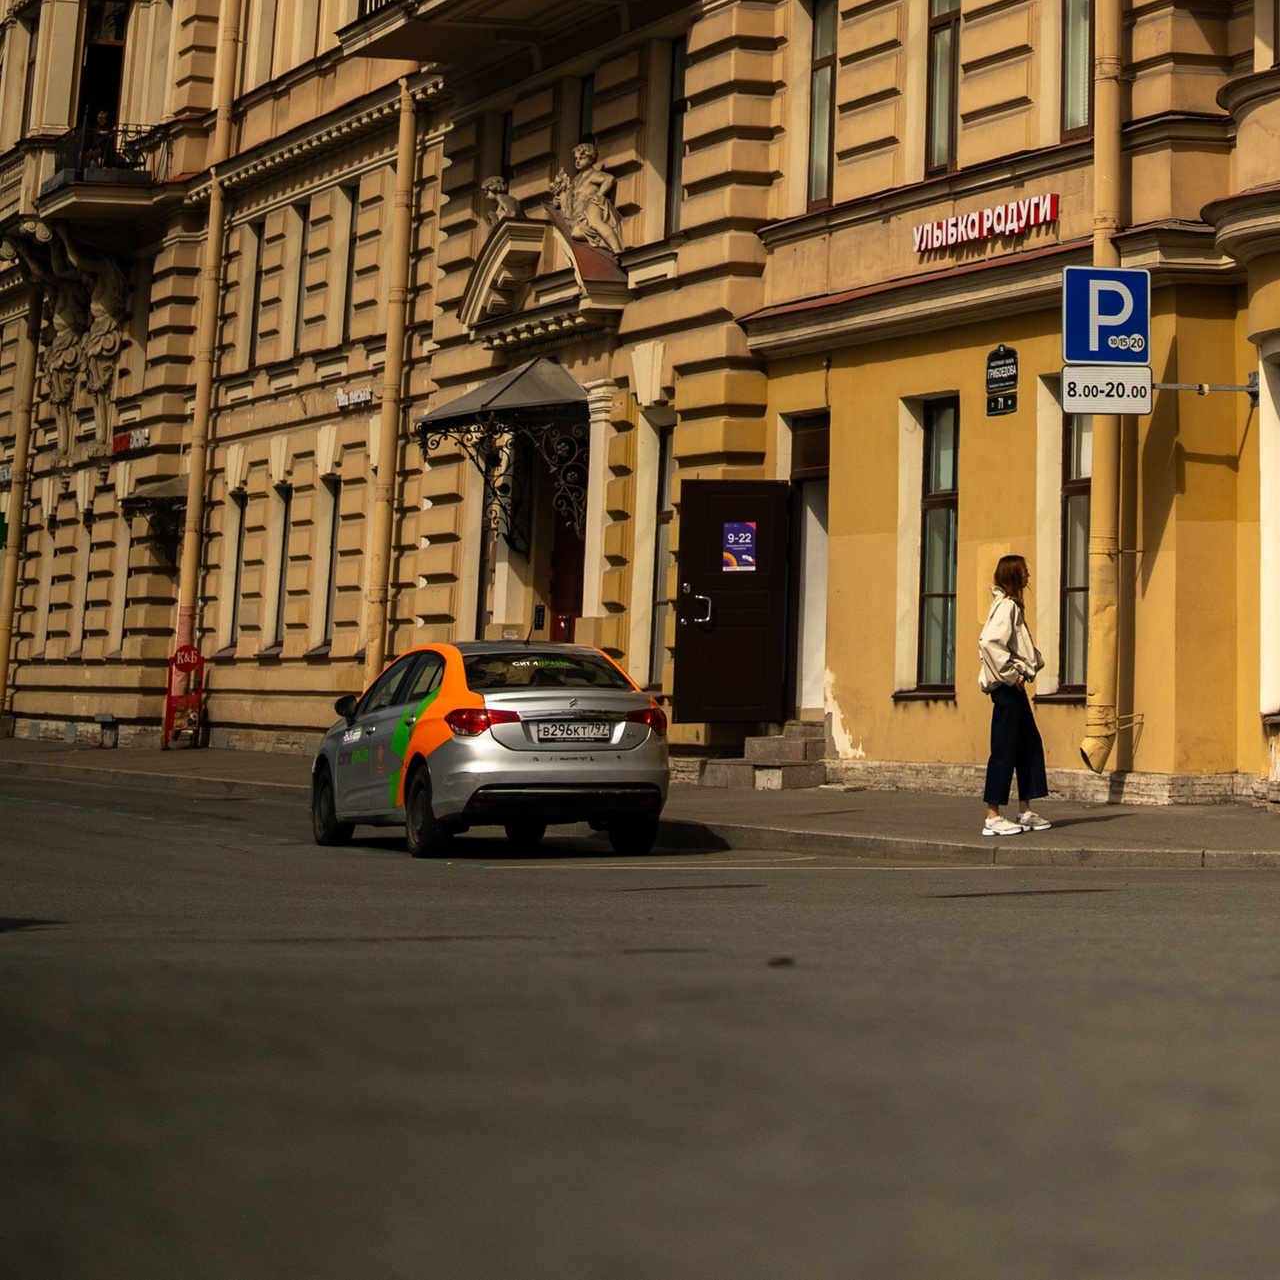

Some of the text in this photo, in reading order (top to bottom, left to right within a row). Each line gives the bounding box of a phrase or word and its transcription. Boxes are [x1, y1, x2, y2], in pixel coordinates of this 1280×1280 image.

[1089, 279, 1134, 351] P
[1120, 337, 1128, 347] 15
[1130, 337, 1143, 348] 20
[1067, 382, 1147, 398] 8.00-20.00
[727, 533, 751, 543] 9-22
[589, 723, 606, 733] 797
